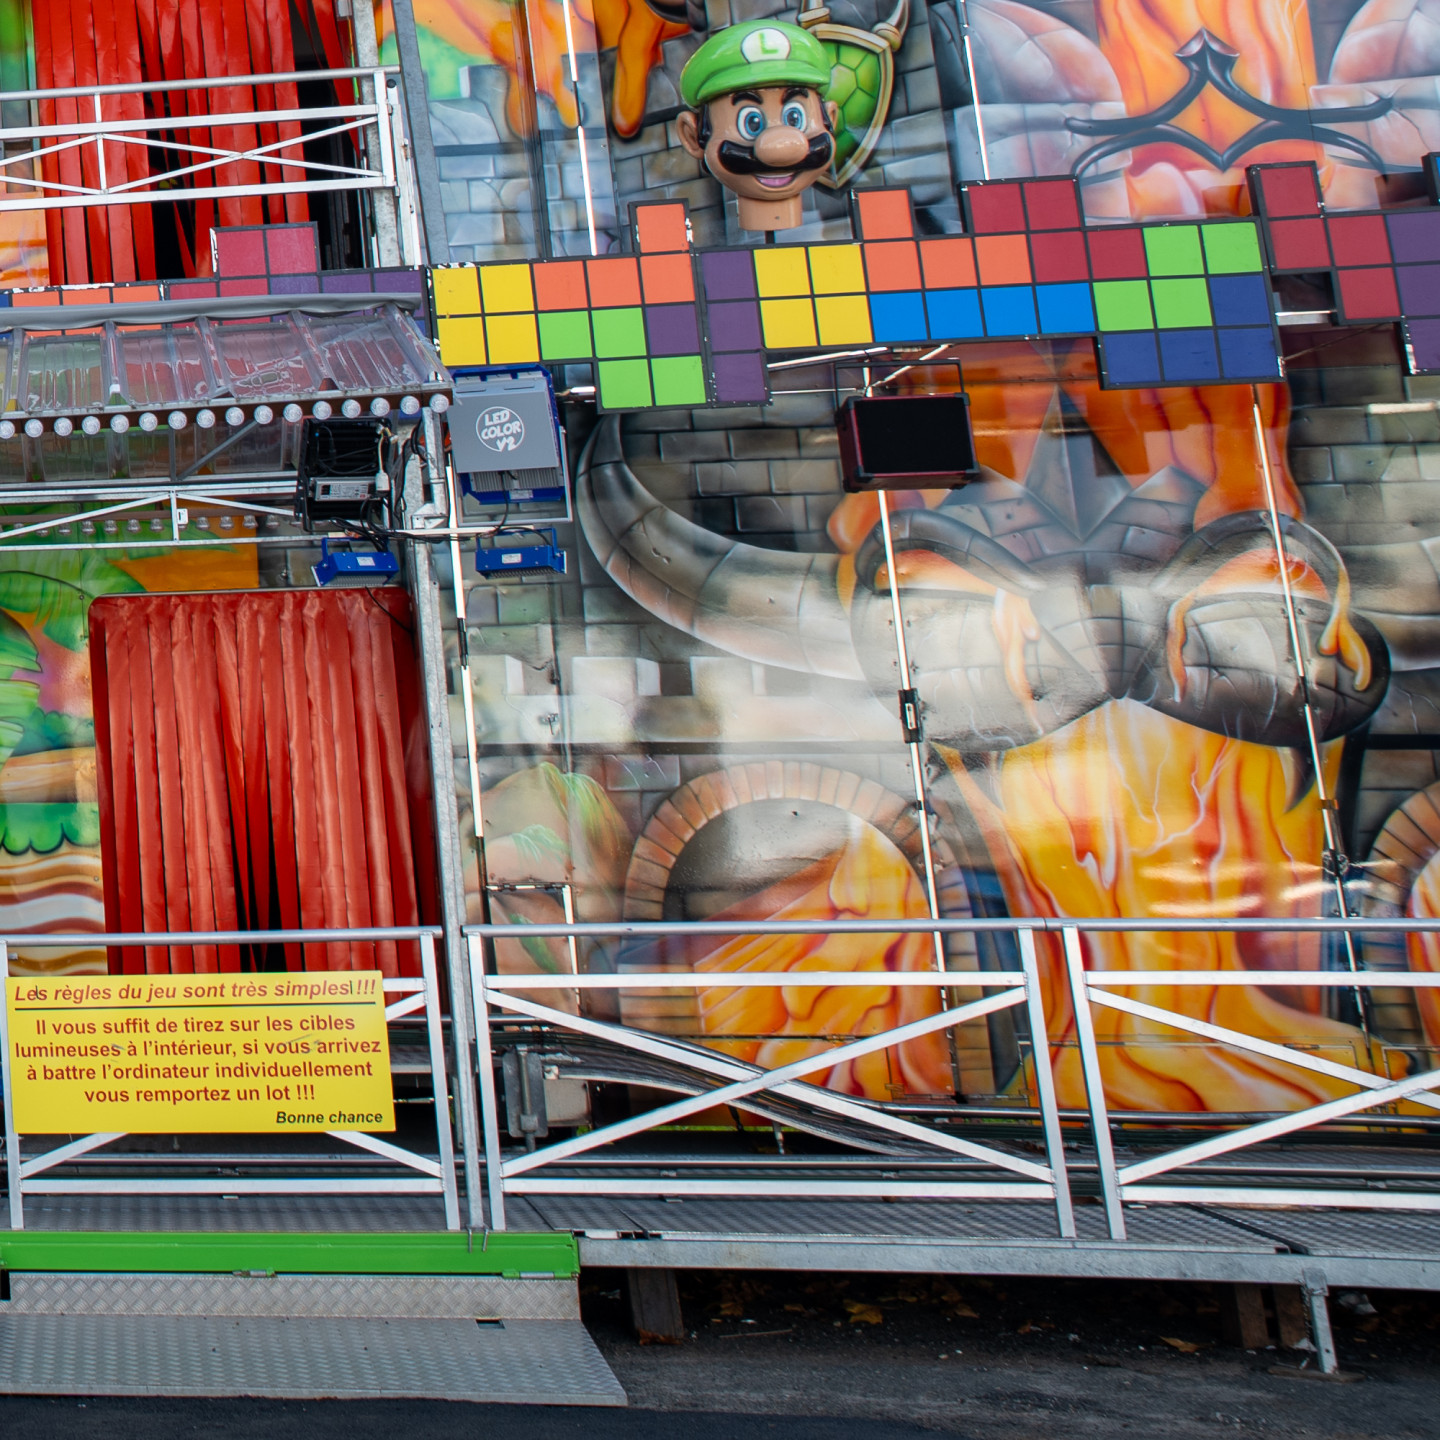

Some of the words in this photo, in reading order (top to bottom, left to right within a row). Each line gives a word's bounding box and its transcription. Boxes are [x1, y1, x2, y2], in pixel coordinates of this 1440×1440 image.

[759, 33, 779, 54] L
[484, 409, 510, 426] LED
[481, 421, 521, 440] COLOR
[15, 986, 48, 1001] Les
[54, 985, 111, 1005] règles
[118, 984, 142, 999] du
[147, 986, 177, 1003] jeu
[183, 983, 225, 998] sont
[231, 981, 267, 997] très
[274, 981, 350, 1000] simples
[36, 1019, 46, 1035] Il
[51, 1022, 97, 1035] vous
[102, 1017, 150, 1034] suffit
[155, 1017, 178, 1033] de
[183, 1017, 225, 1033] tirez
[230, 1019, 260, 1032] sur
[266, 1015, 293, 1031] les
[299, 1015, 355, 1031] cibles
[15, 1042, 121, 1058] lumineuses
[127, 1041, 137, 1057] à
[242, 1039, 259, 1055] si
[264, 1041, 310, 1055] vous
[317, 1038, 382, 1054] arrivez
[27, 1065, 37, 1081] à
[43, 1065, 96, 1081] battre
[215, 1061, 373, 1078] individuellement
[84, 1089, 130, 1103] vous
[136, 1086, 231, 1106] remportez
[236, 1088, 260, 1101] un
[266, 1084, 291, 1101] lot
[276, 1111, 325, 1124] Bonne
[328, 1110, 383, 1124] chance
